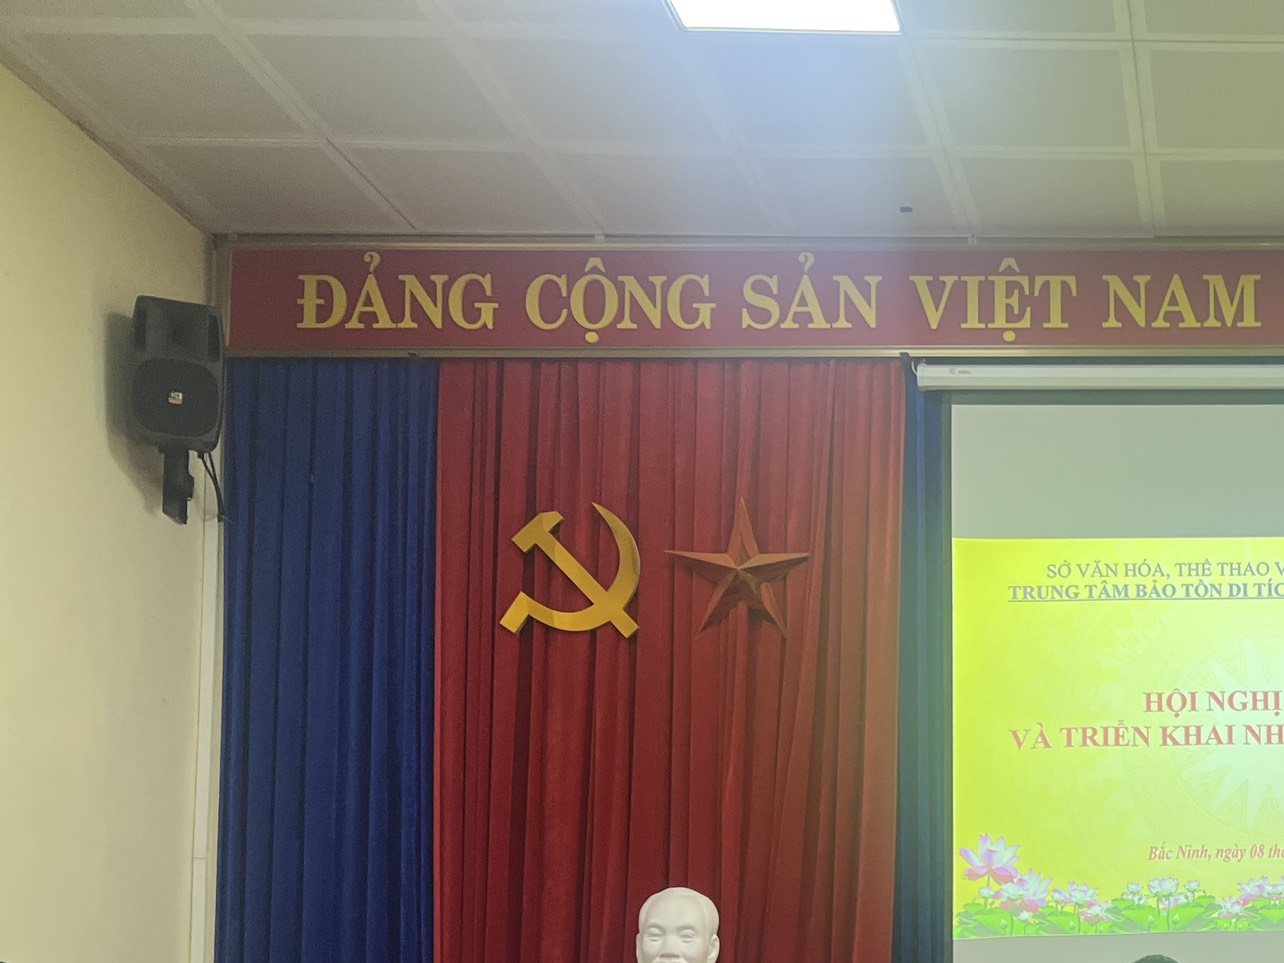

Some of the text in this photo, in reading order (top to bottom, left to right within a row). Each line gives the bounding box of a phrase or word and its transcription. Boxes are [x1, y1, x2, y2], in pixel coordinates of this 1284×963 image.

[296, 251, 497, 331] ĐẢNG
[525, 258, 718, 343] CỘNG
[741, 252, 882, 331] SẢN
[910, 258, 1076, 342] VIỆT
[1102, 274, 1262, 329] NAM
[1046, 561, 1072, 579] SỞ
[1077, 559, 1119, 578] VĂN
[1123, 558, 1171, 580] HÓA,
[1216, 561, 1271, 577] THAO
[1008, 585, 1081, 601] TRUNG
[1084, 580, 1130, 600] TÂM
[1135, 579, 1177, 599] BẢO
[1181, 579, 1223, 598] TỒN
[1227, 583, 1249, 598] DI
[1142, 688, 1199, 718] HỘI
[1205, 690, 1282, 717] NGHỊ
[1009, 722, 1052, 750] VÀ
[1159, 724, 1236, 746] KHAI
[1147, 841, 1173, 861] Bắc
[1176, 844, 1212, 861] Ninh,
[1215, 846, 1247, 862] ngày
[1249, 843, 1265, 859] 08
